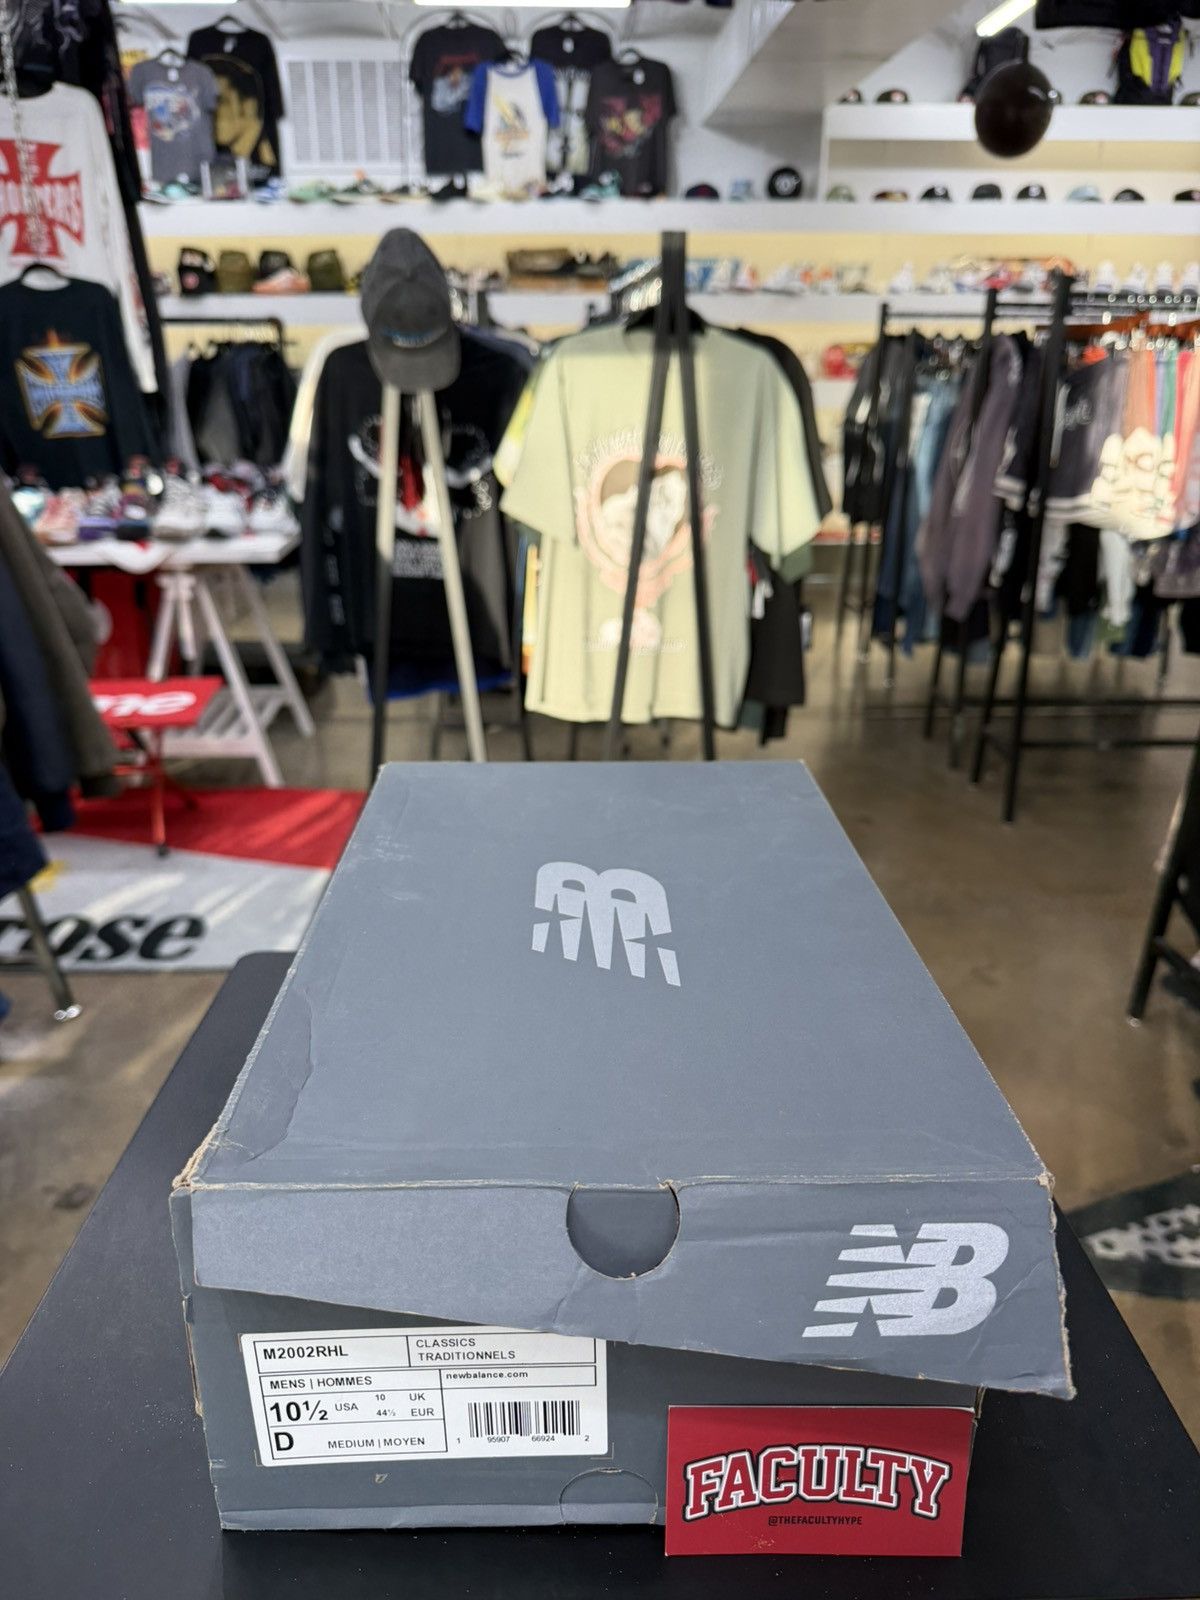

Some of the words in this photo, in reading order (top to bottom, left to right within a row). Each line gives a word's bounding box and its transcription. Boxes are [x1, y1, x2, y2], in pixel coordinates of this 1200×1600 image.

[416, 1338, 476, 1348] CLASSICS
[263, 1345, 349, 1360] M2002RHL
[418, 1350, 516, 1361] TRADITIONNELS
[446, 1370, 529, 1380] newbalance.com
[270, 1379, 306, 1390] MENS
[317, 1376, 372, 1388] HOMMES
[375, 1393, 386, 1401] 10
[409, 1392, 426, 1401] UK
[334, 1402, 359, 1412] USA
[411, 1407, 435, 1417] EUR
[274, 1431, 294, 1451] D
[328, 1438, 375, 1449] MEDIUM
[384, 1437, 425, 1447] MOYEN
[584, 1434, 590, 1442] 2
[684, 1443, 952, 1521] FACULTY
[768, 1515, 863, 1526] @THEFACULTYHYPE
